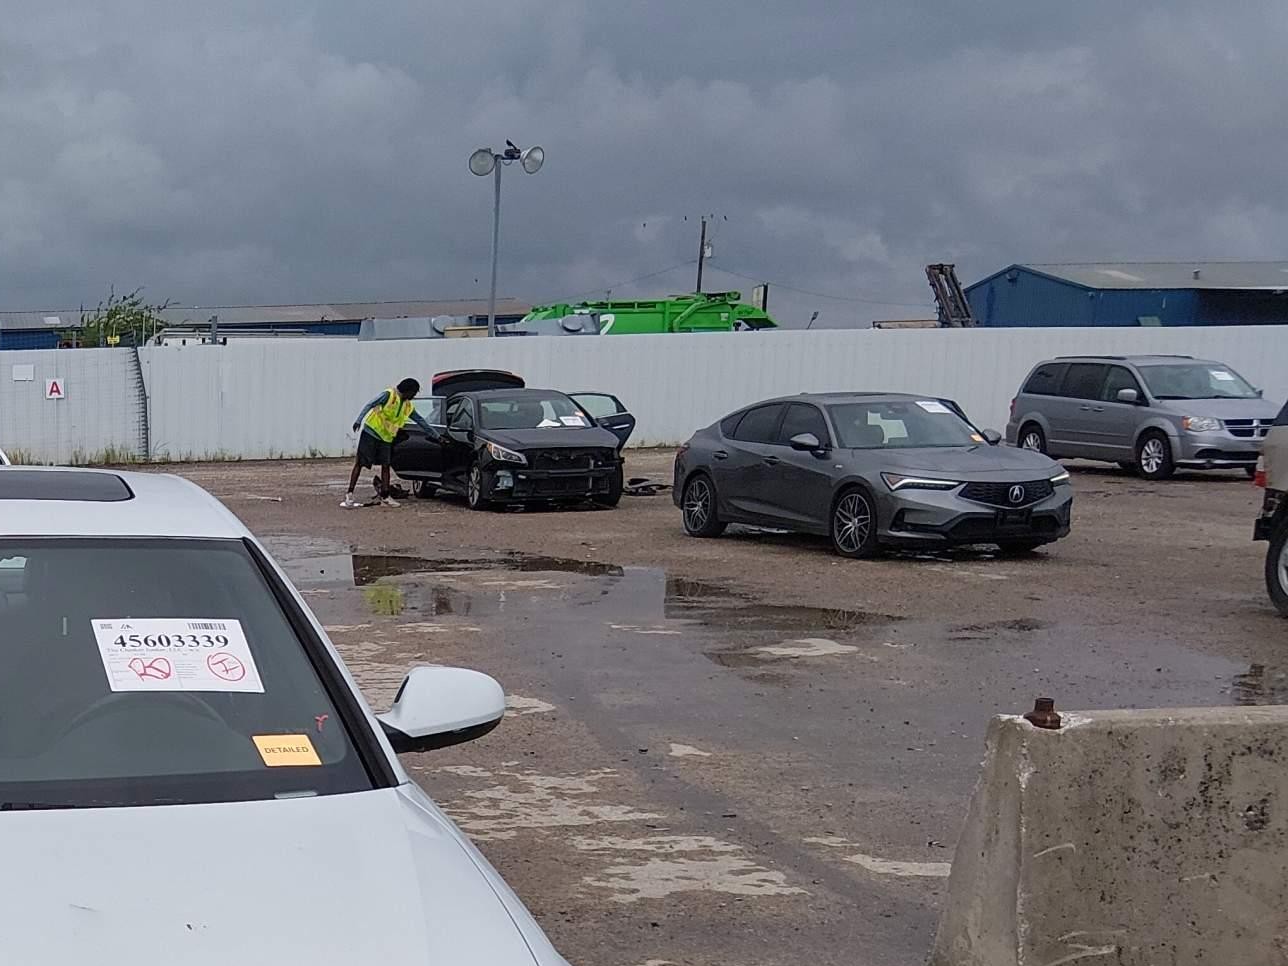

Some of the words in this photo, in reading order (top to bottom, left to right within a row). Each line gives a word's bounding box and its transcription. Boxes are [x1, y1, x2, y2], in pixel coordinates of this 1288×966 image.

[49, 381, 61, 396] A
[113, 634, 229, 648] 45603339
[263, 746, 309, 754] DETAILED
